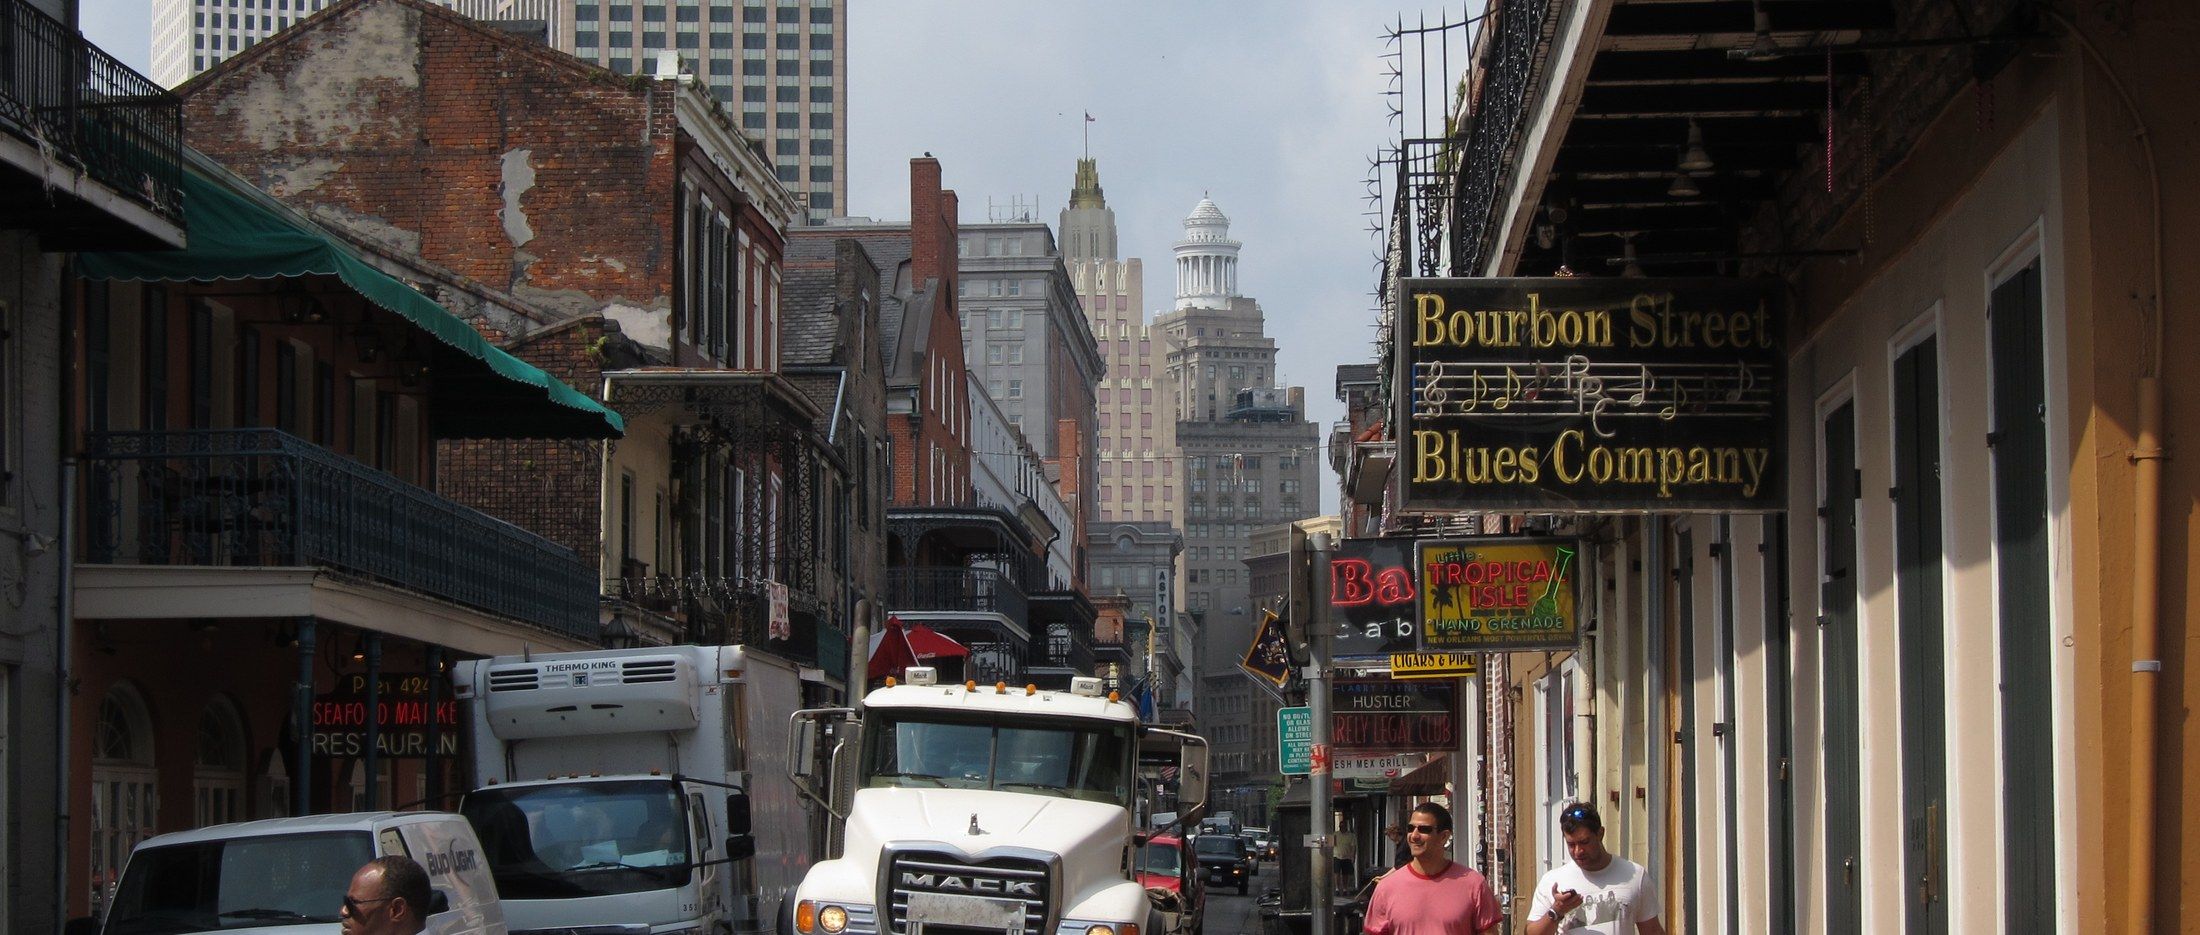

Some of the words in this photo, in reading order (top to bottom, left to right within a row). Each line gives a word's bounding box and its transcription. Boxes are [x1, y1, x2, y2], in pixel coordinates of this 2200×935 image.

[1412, 291, 1615, 349] Bourbon
[1630, 292, 1776, 350] Street
[1412, 430, 1540, 484] Blues
[1553, 428, 1770, 498] Company
[1436, 551, 1475, 564] Little
[1427, 560, 1569, 585] TROPICAL
[1159, 571, 1167, 627] ASTOR
[1470, 585, 1530, 608] ISLE
[1435, 618, 1481, 632] HAND
[1487, 617, 1564, 631] GRENADE
[1505, 634, 1547, 642] POWERFUL
[545, 663, 589, 672] THERMO
[591, 661, 616, 669] KING
[1394, 653, 1434, 669] CIGARS
[1449, 652, 1477, 666] PIPE
[1353, 695, 1412, 708] HUSTLER
[313, 702, 389, 725] SEAFOD
[1374, 714, 1415, 744] LEGAL
[1419, 713, 1451, 744] CLUB
[313, 732, 457, 755] RESAURN
[1356, 759, 1375, 769] MEX
[1379, 758, 1407, 768] GRILL
[426, 852, 450, 876] BUD
[902, 872, 1041, 896] MACK
